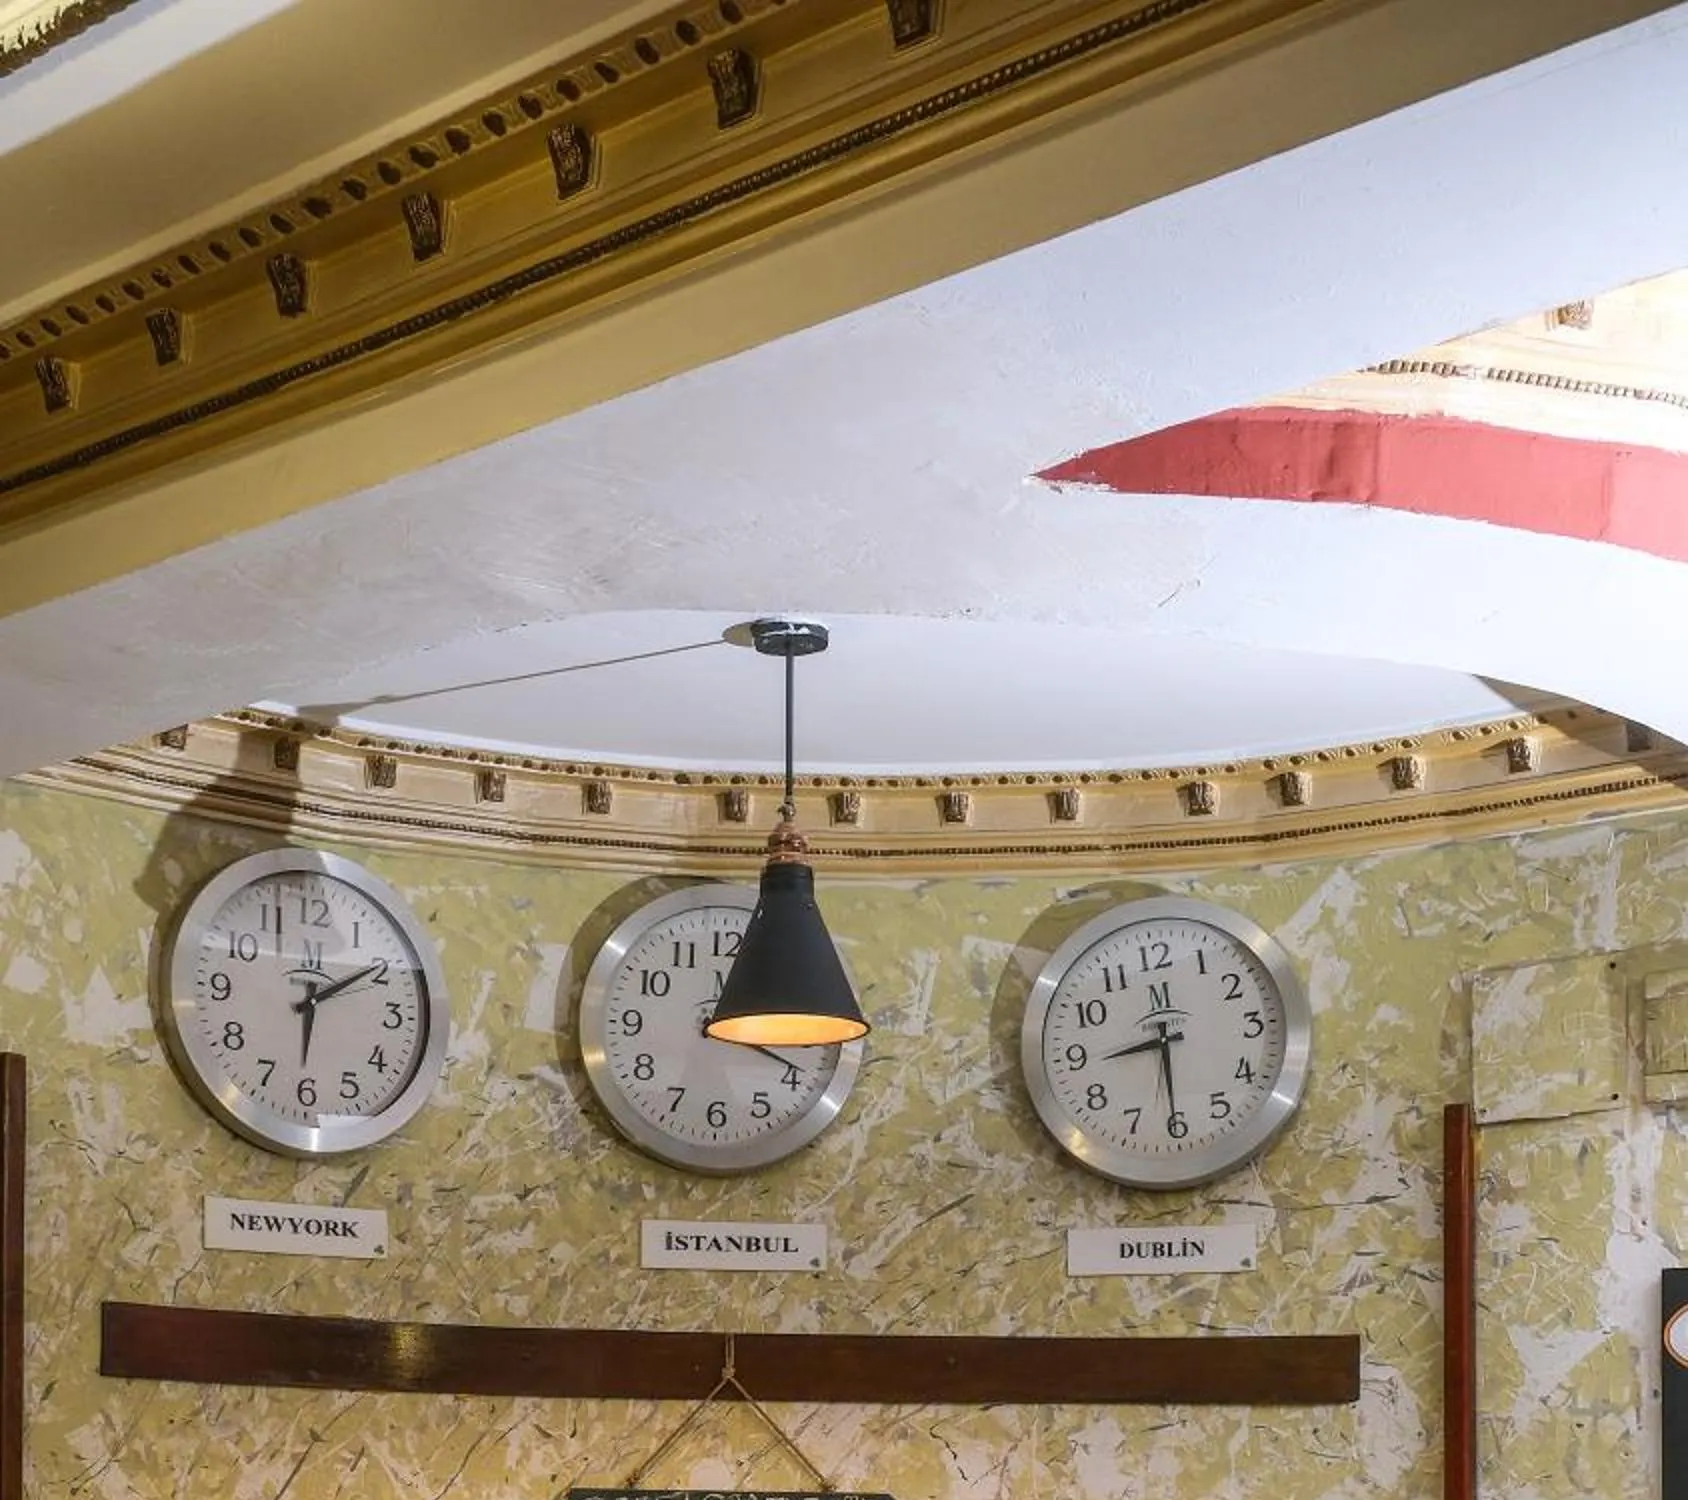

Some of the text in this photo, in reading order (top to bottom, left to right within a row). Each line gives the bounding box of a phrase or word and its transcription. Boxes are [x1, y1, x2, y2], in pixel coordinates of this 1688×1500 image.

[259, 903, 283, 935] 11
[300, 898, 332, 928] 12
[228, 931, 258, 963] 10
[351, 921, 360, 949] 1
[712, 931, 744, 957] 12
[672, 941, 696, 969] 11
[1138, 942, 1173, 973] 12
[1195, 949, 1209, 974] 1
[372, 957, 389, 986] 2
[640, 970, 671, 997] 10
[1101, 964, 1129, 993] 11
[211, 973, 232, 1001] 9
[1221, 973, 1243, 1001] 2
[383, 1002, 403, 1030] 3
[622, 1009, 644, 1036] 9
[1077, 1000, 1107, 1029] 10
[1243, 1011, 1264, 1039] 3
[223, 1021, 245, 1051] 8
[368, 1045, 389, 1074] 4
[633, 1053, 655, 1080] 8
[1066, 1044, 1088, 1071] 9
[1235, 1057, 1257, 1085] 4
[257, 1059, 276, 1087] 7
[339, 1072, 360, 1099] 5
[780, 1064, 801, 1091] 4
[297, 1078, 317, 1107] 6
[667, 1087, 686, 1113] 7
[751, 1092, 771, 1119] 5
[1087, 1084, 1107, 1111] 8
[1209, 1091, 1230, 1119] 5
[706, 1101, 728, 1128] 6
[1124, 1108, 1142, 1135] 7
[1167, 1111, 1188, 1139] 6
[230, 1212, 360, 1240] NEWYORK
[664, 1231, 799, 1253] İSTANBUL
[1119, 1237, 1205, 1259] DUBLİN
